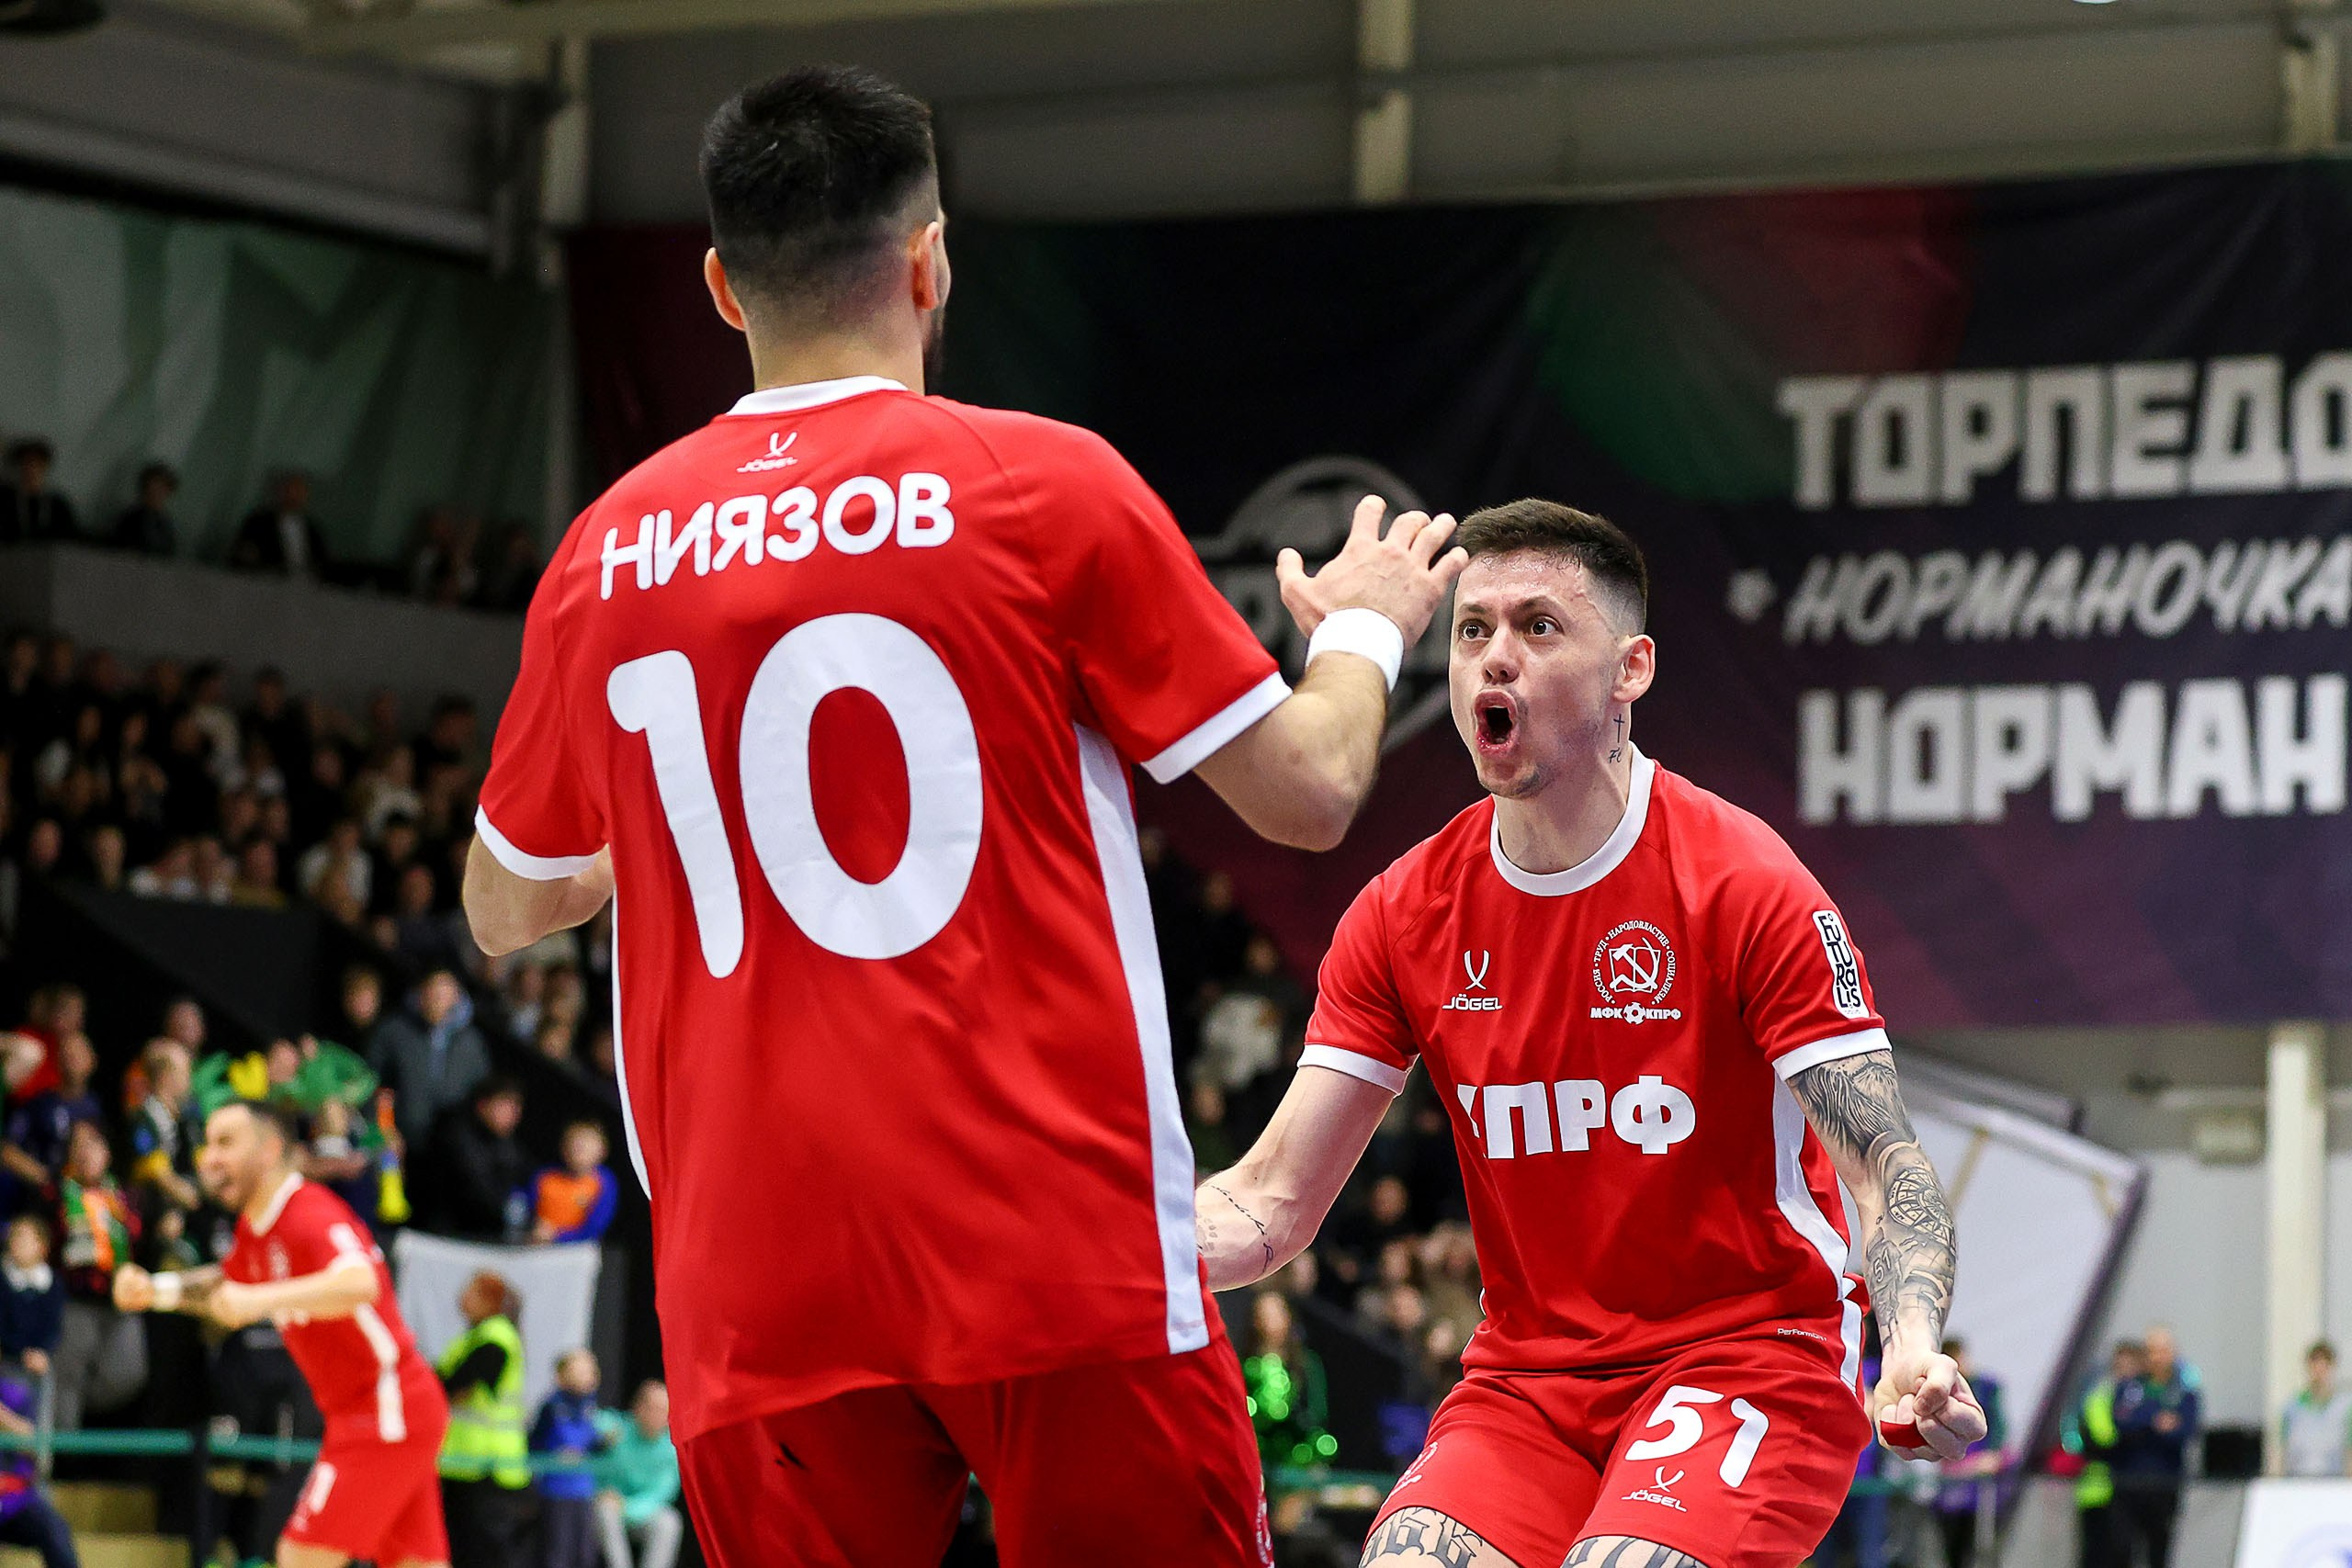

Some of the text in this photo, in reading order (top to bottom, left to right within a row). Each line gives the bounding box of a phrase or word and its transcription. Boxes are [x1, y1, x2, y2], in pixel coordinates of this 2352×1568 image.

[1778, 353, 2352, 506] ТОРПЕДО
[600, 472, 956, 601] НИЯЗОВ
[1784, 536, 2352, 643] НОРМАНОЧКА
[606, 612, 984, 979] 10
[1442, 993, 1503, 1011] JÖGEL
[1593, 939, 1609, 963] ТРУД
[1589, 1007, 1681, 1021] МФК КПРФ
[1625, 1385, 1770, 1488] 51
[1621, 1489, 1688, 1513] JÖGEL
